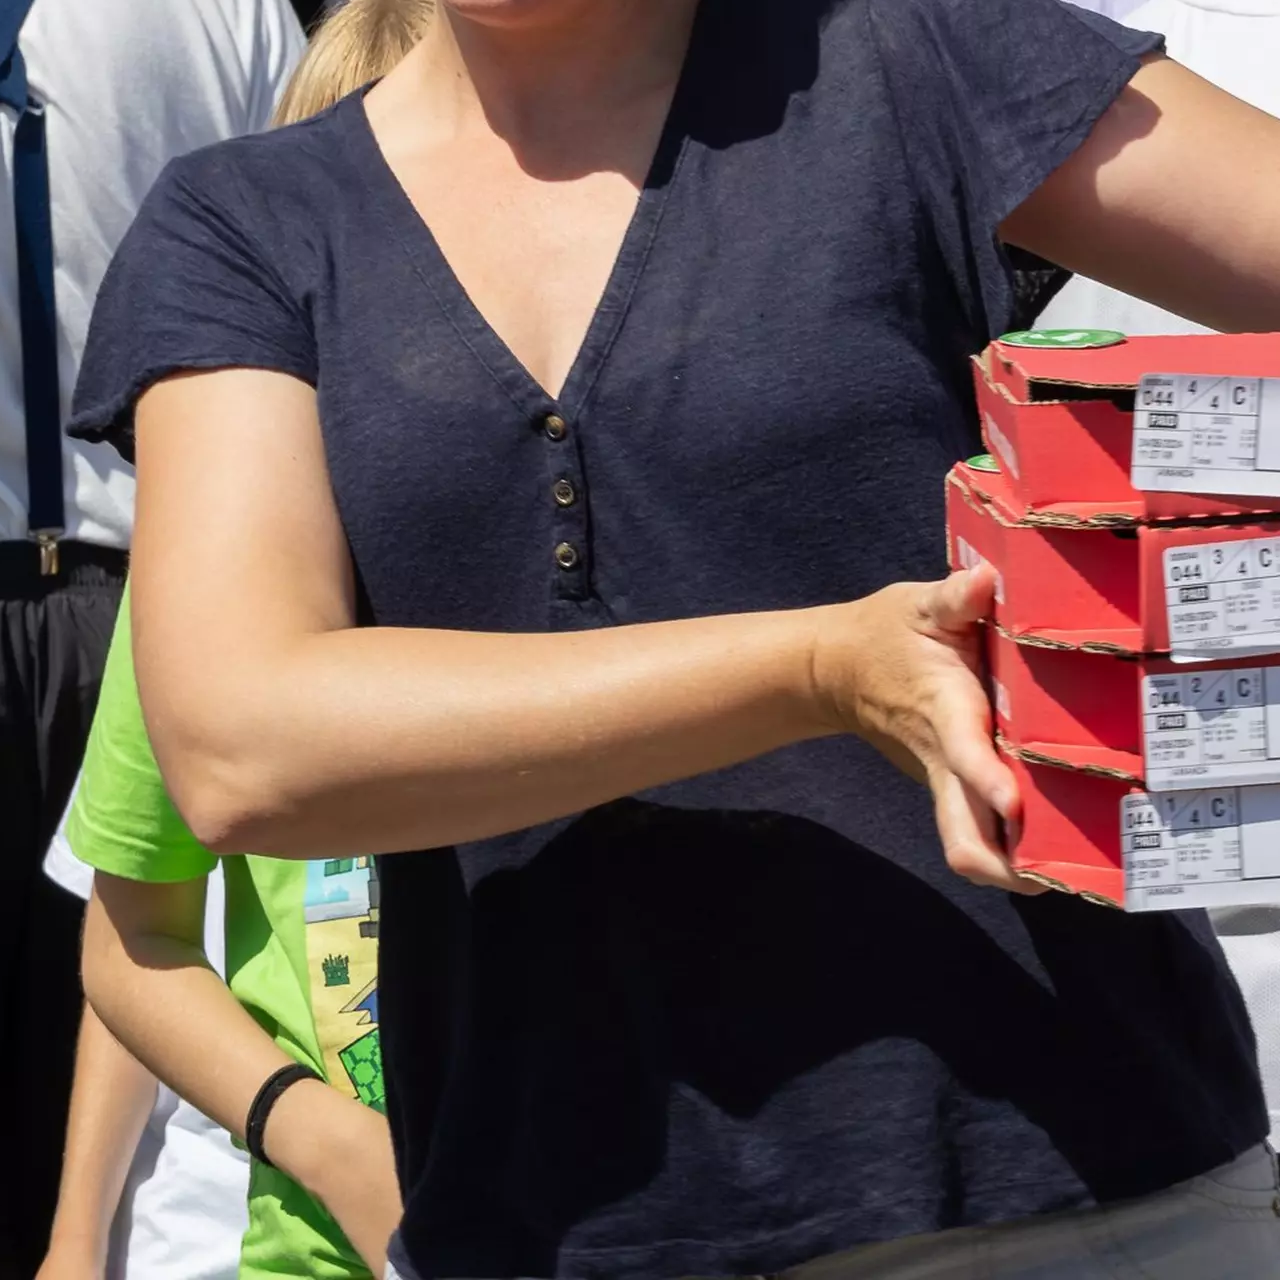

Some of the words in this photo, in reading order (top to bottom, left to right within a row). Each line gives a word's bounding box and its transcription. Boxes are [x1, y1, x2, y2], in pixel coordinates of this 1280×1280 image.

[1187, 380, 1197, 394] 4
[1143, 390, 1173, 406] 044
[1210, 395, 1219, 408] 4
[1233, 386, 1246, 405] C
[1213, 549, 1224, 565] 3
[1259, 548, 1272, 568] C
[1171, 565, 1201, 582] 044
[1238, 561, 1248, 574] 4
[1191, 677, 1202, 693] 2
[1237, 678, 1251, 698] C
[1149, 691, 1180, 709] 044
[1216, 690, 1225, 703] 4
[1166, 798, 1176, 812] 1
[1211, 797, 1226, 818] C
[1126, 811, 1153, 829] 044
[1189, 809, 1200, 822] 4
